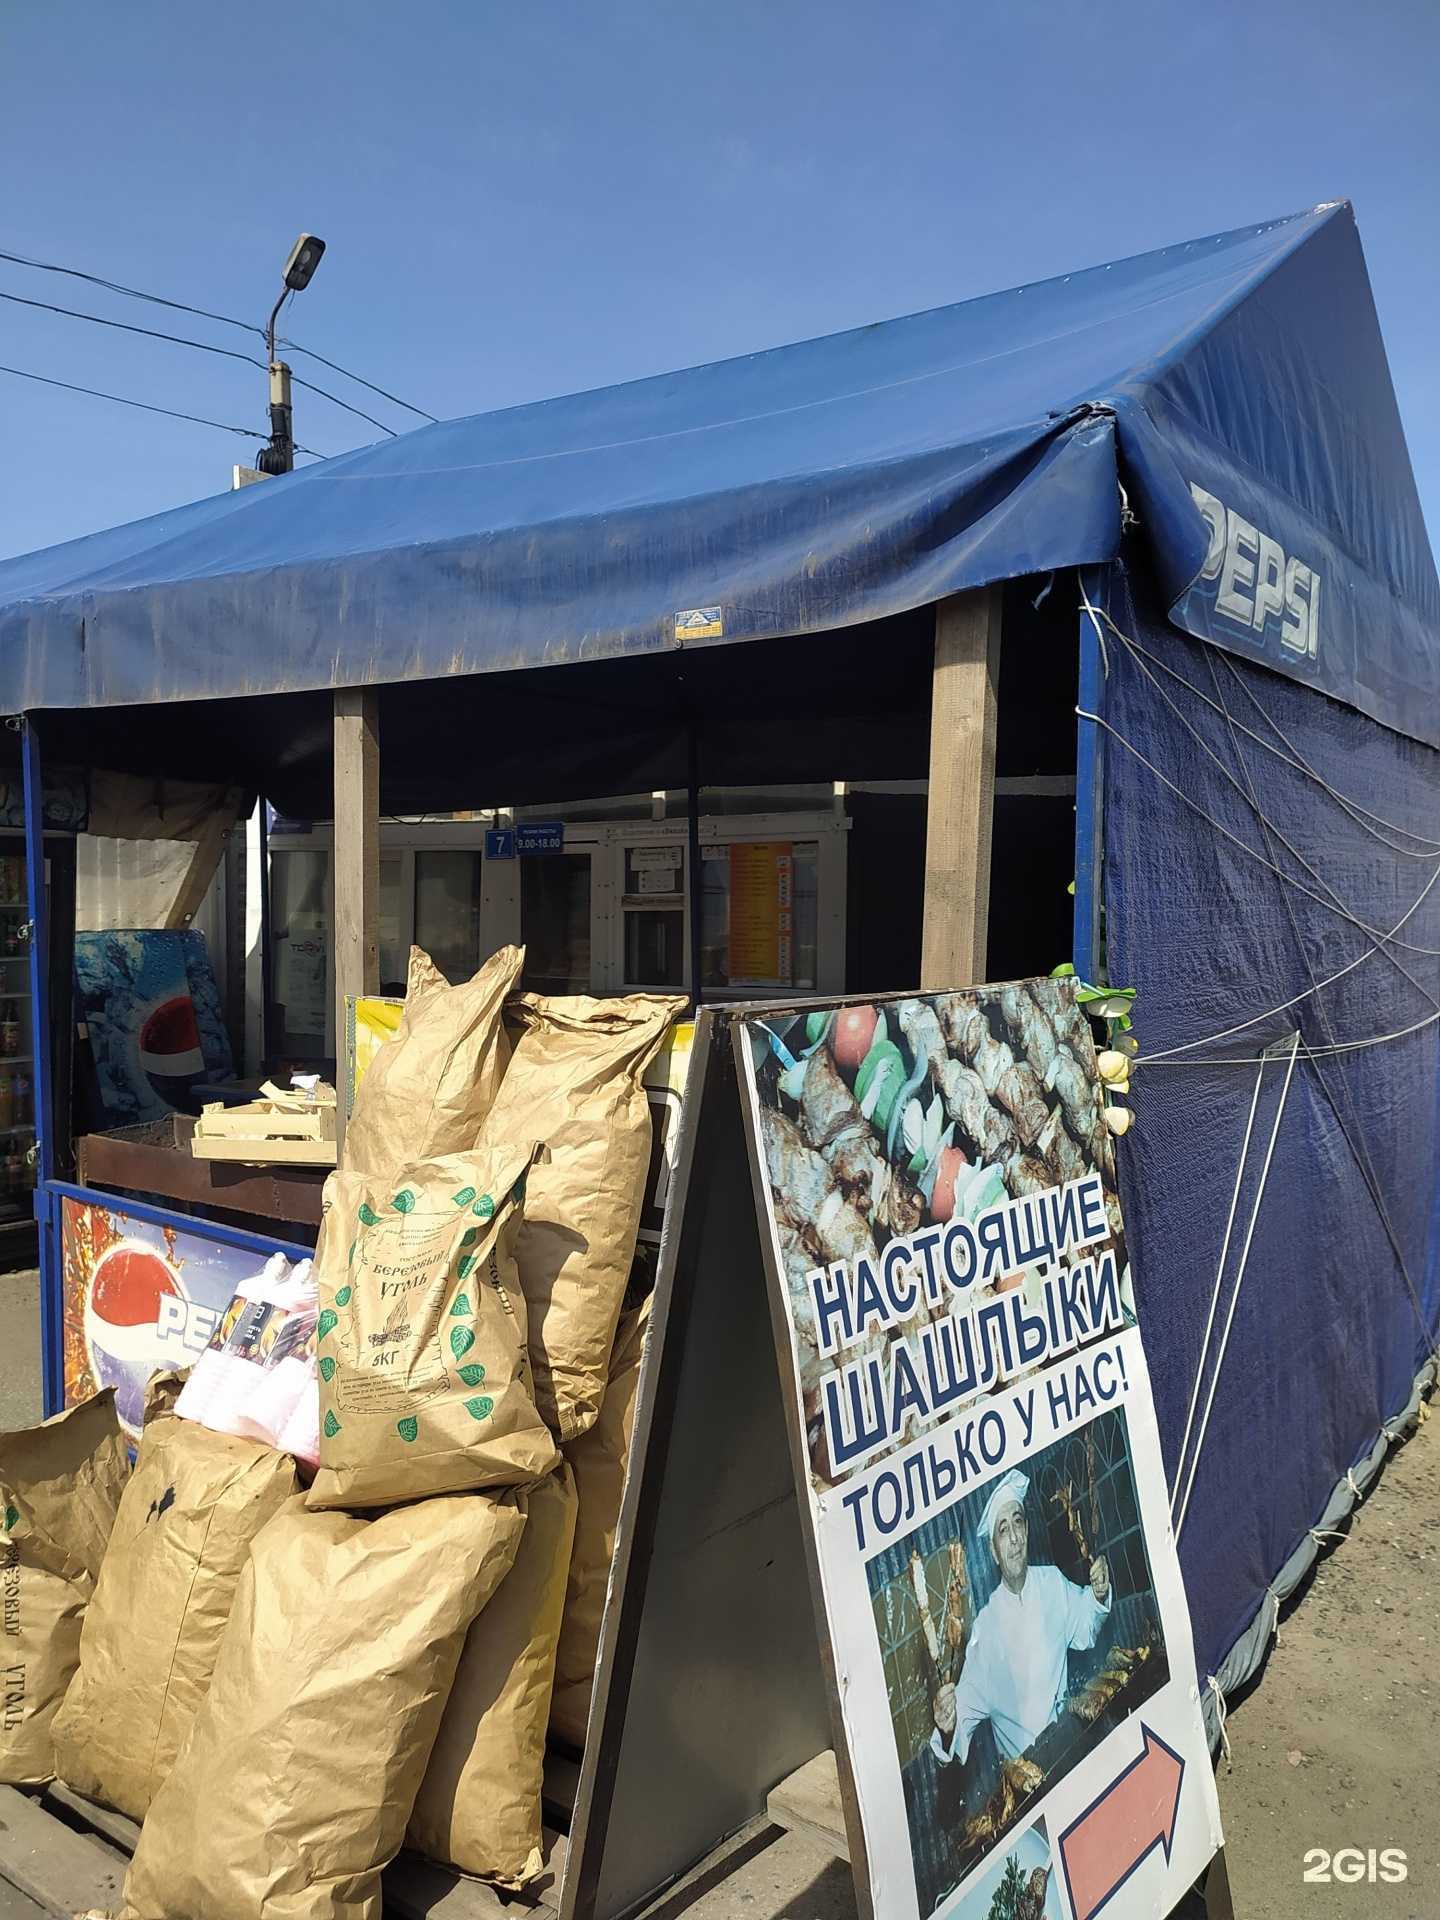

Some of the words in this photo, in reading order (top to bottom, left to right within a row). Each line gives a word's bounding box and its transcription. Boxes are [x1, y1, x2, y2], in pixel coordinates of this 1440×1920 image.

[495, 836, 505, 853] 7
[517, 838, 561, 849] 9.00-18.00
[380, 1271, 428, 1300] УГОЛЬ
[812, 1179, 1106, 1350] НАСТОЯЩИЕ
[156, 1291, 224, 1354] PE
[371, 1350, 400, 1367] 5КГ
[826, 1256, 1120, 1467] ШАШЛЫКИ
[842, 1408, 1007, 1552] ТОЛЬКО
[1013, 1388, 1035, 1447] У
[1046, 1344, 1130, 1430] НАС!
[2, 1663, 26, 1731] УГОЛЬ
